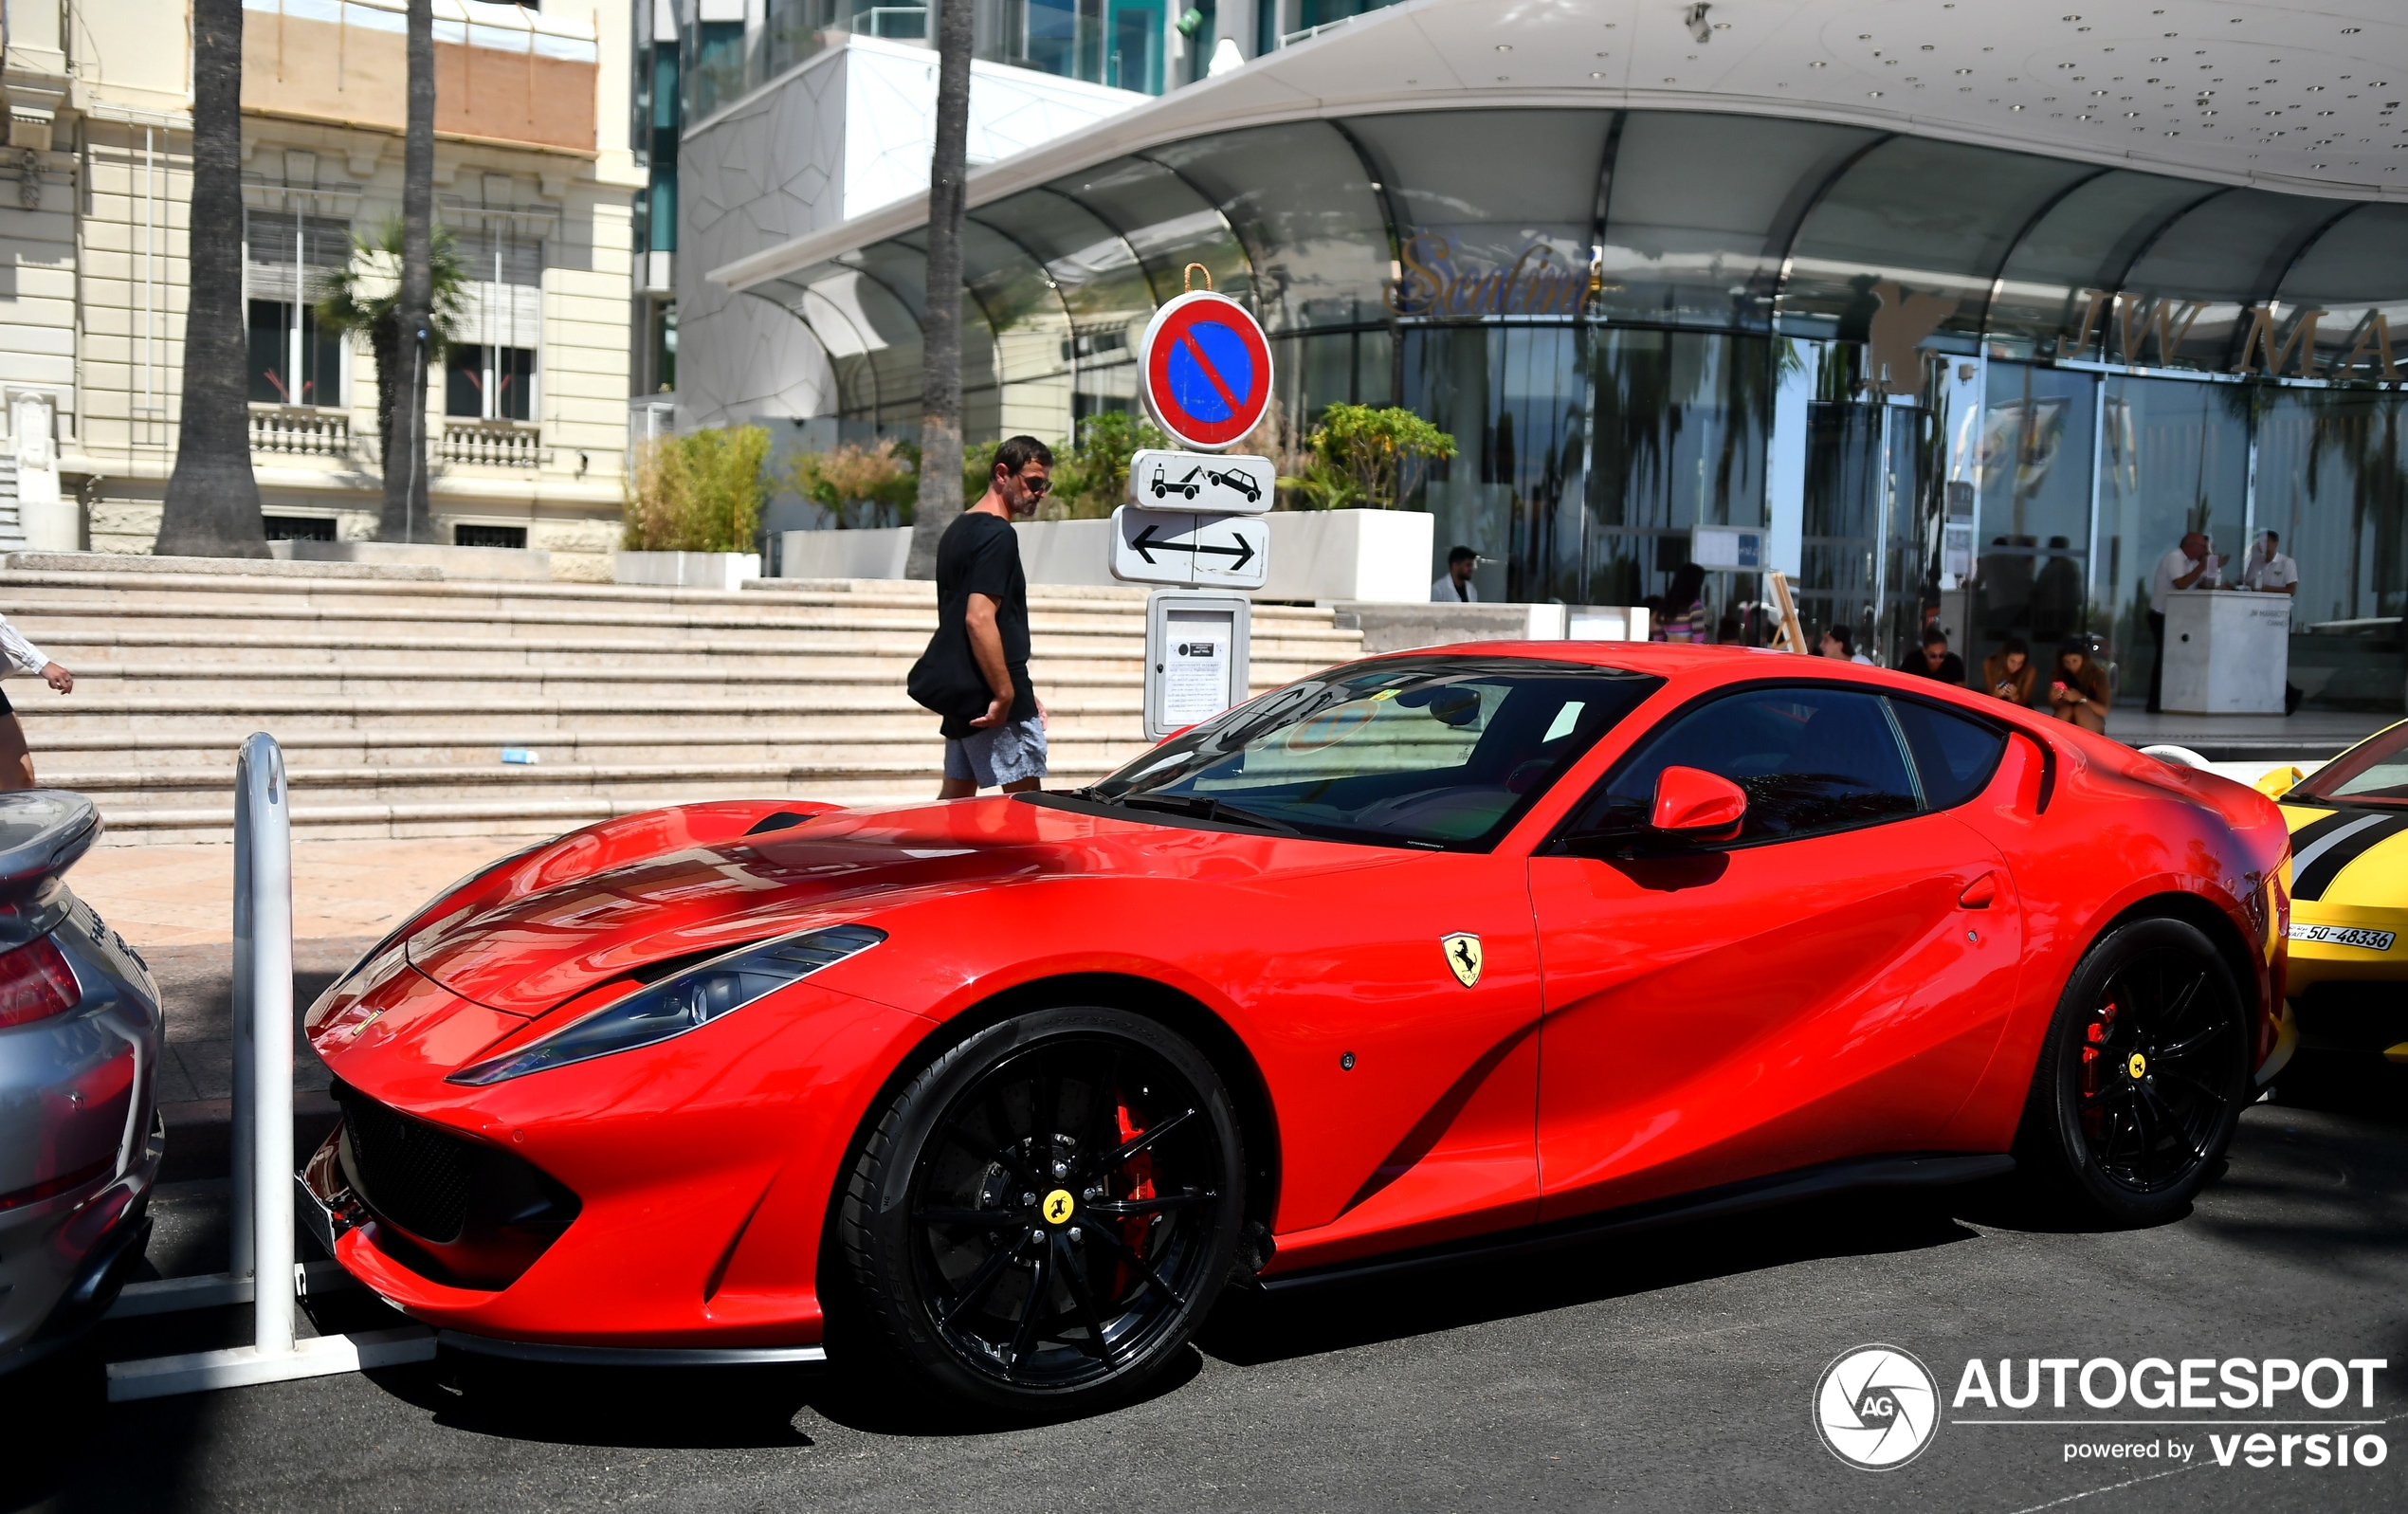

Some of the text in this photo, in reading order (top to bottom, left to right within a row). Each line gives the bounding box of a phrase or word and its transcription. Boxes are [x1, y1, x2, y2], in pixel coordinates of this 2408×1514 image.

[2057, 288, 2407, 379] JW MA
[2307, 926, 2389, 948] 50-48336
